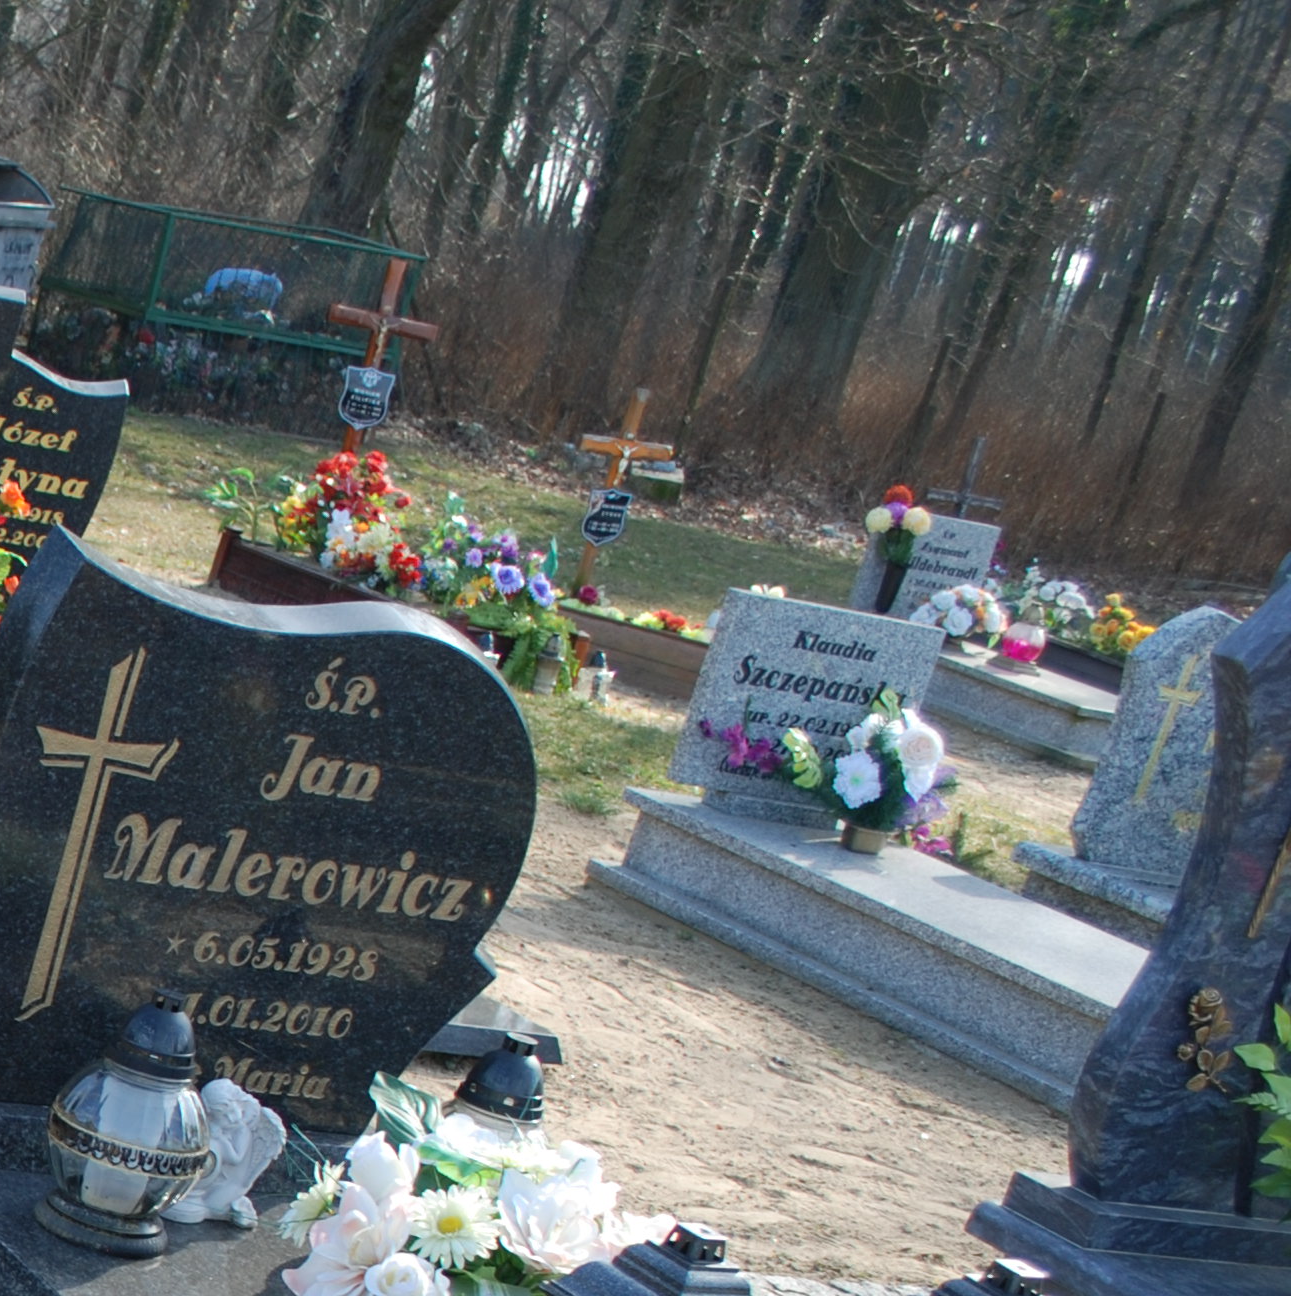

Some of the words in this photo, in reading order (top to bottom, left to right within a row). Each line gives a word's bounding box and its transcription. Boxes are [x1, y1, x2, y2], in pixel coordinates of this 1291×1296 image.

[12, 387, 58, 414] Ś.P.
[793, 630, 877, 662] Klaudia
[305, 656, 382, 718] Ś.P.
[260, 734, 382, 803] Jan
[104, 813, 473, 923] Malerowicz
[193, 932, 380, 982] 6.05.1928
[215, 1055, 331, 1099] Maria
